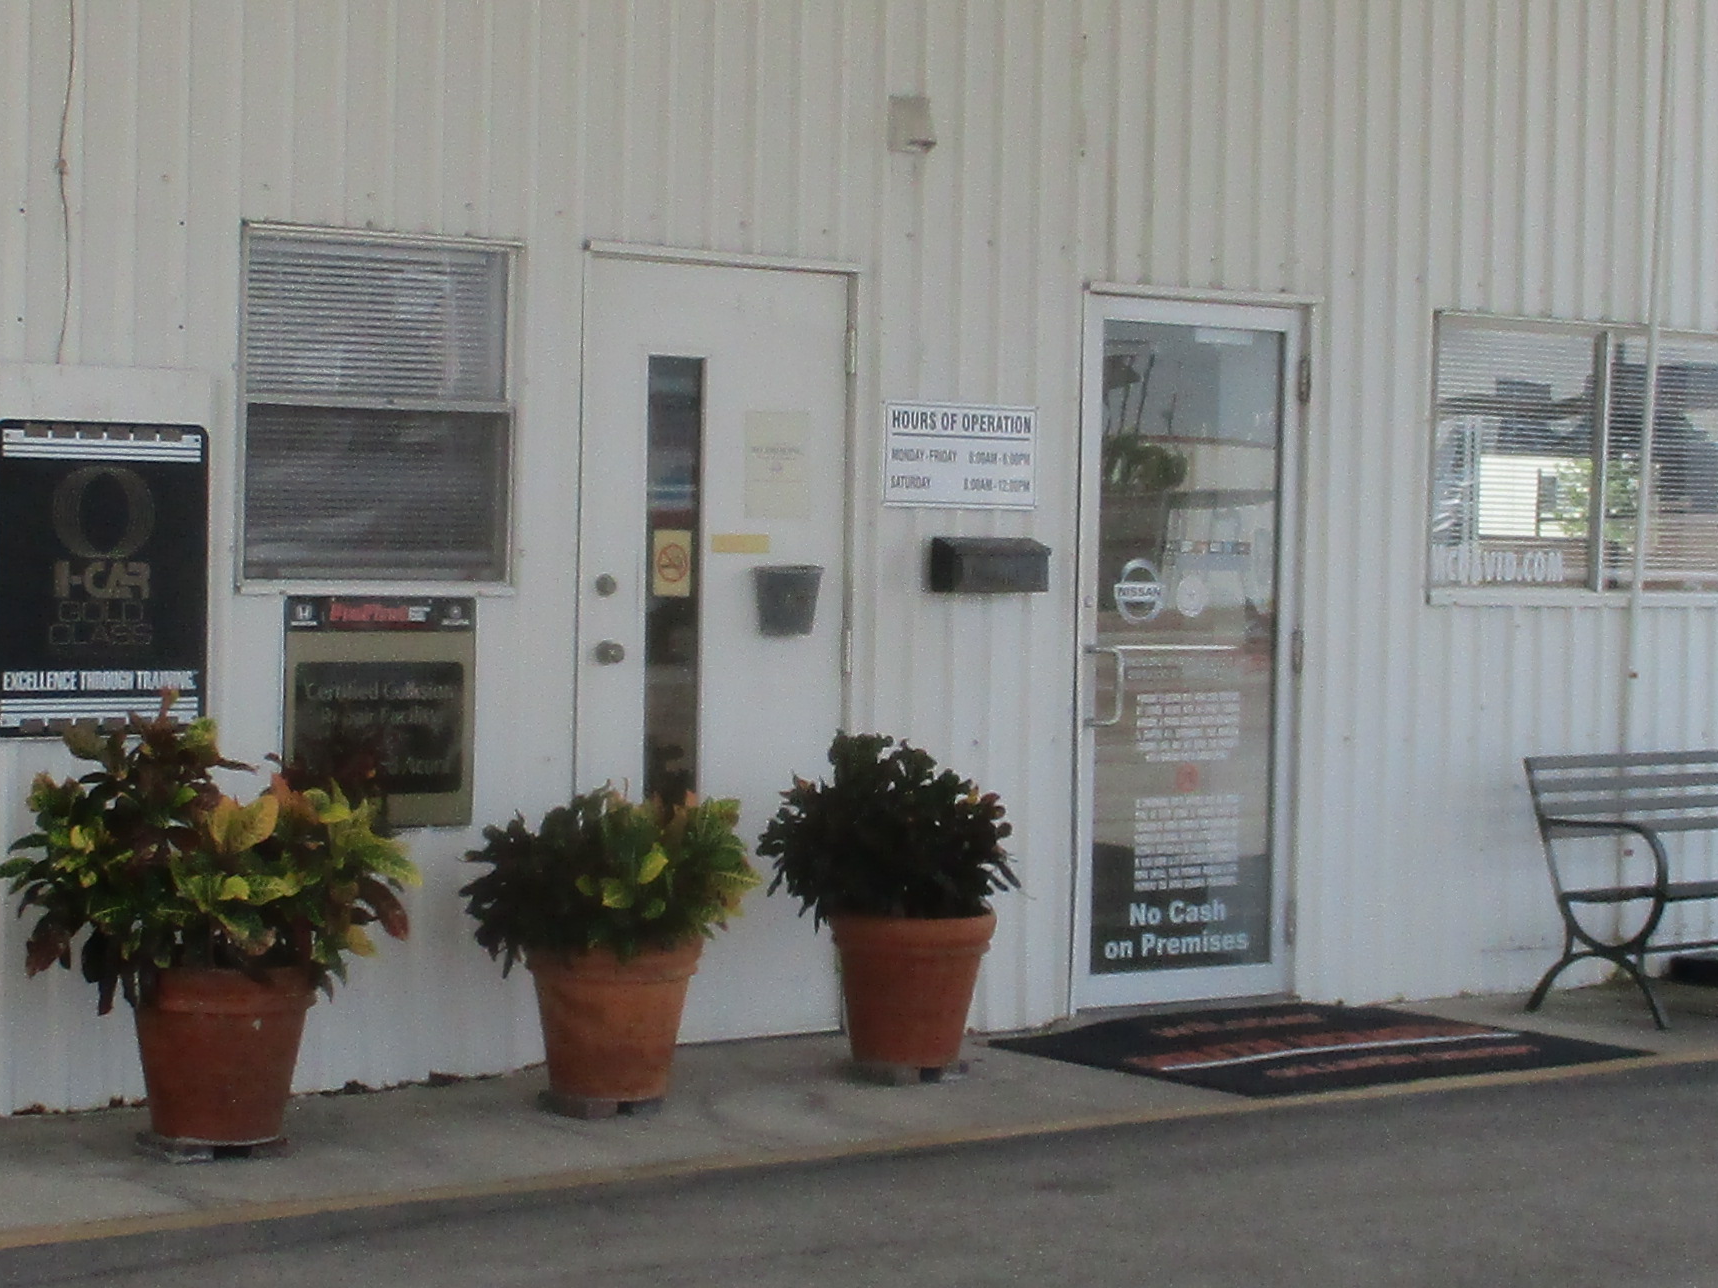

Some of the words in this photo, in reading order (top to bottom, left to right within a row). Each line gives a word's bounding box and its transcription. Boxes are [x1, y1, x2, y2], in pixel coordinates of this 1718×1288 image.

[892, 410, 937, 431] HOURS
[941, 412, 958, 431] OF
[962, 413, 1032, 434] OPERATION
[890, 475, 931, 489] SATURDAY
[52, 560, 151, 600] I-CAR
[1117, 585, 1163, 598] NISSAN
[58, 600, 144, 623] GOLD
[48, 622, 154, 646] CLASS
[2, 670, 78, 691] EXCELLENCE
[79, 670, 134, 691] THROUGH
[1129, 902, 1161, 926] No
[1168, 898, 1227, 925] Cash
[1104, 939, 1133, 959] on
[1141, 929, 1250, 958] Premises
